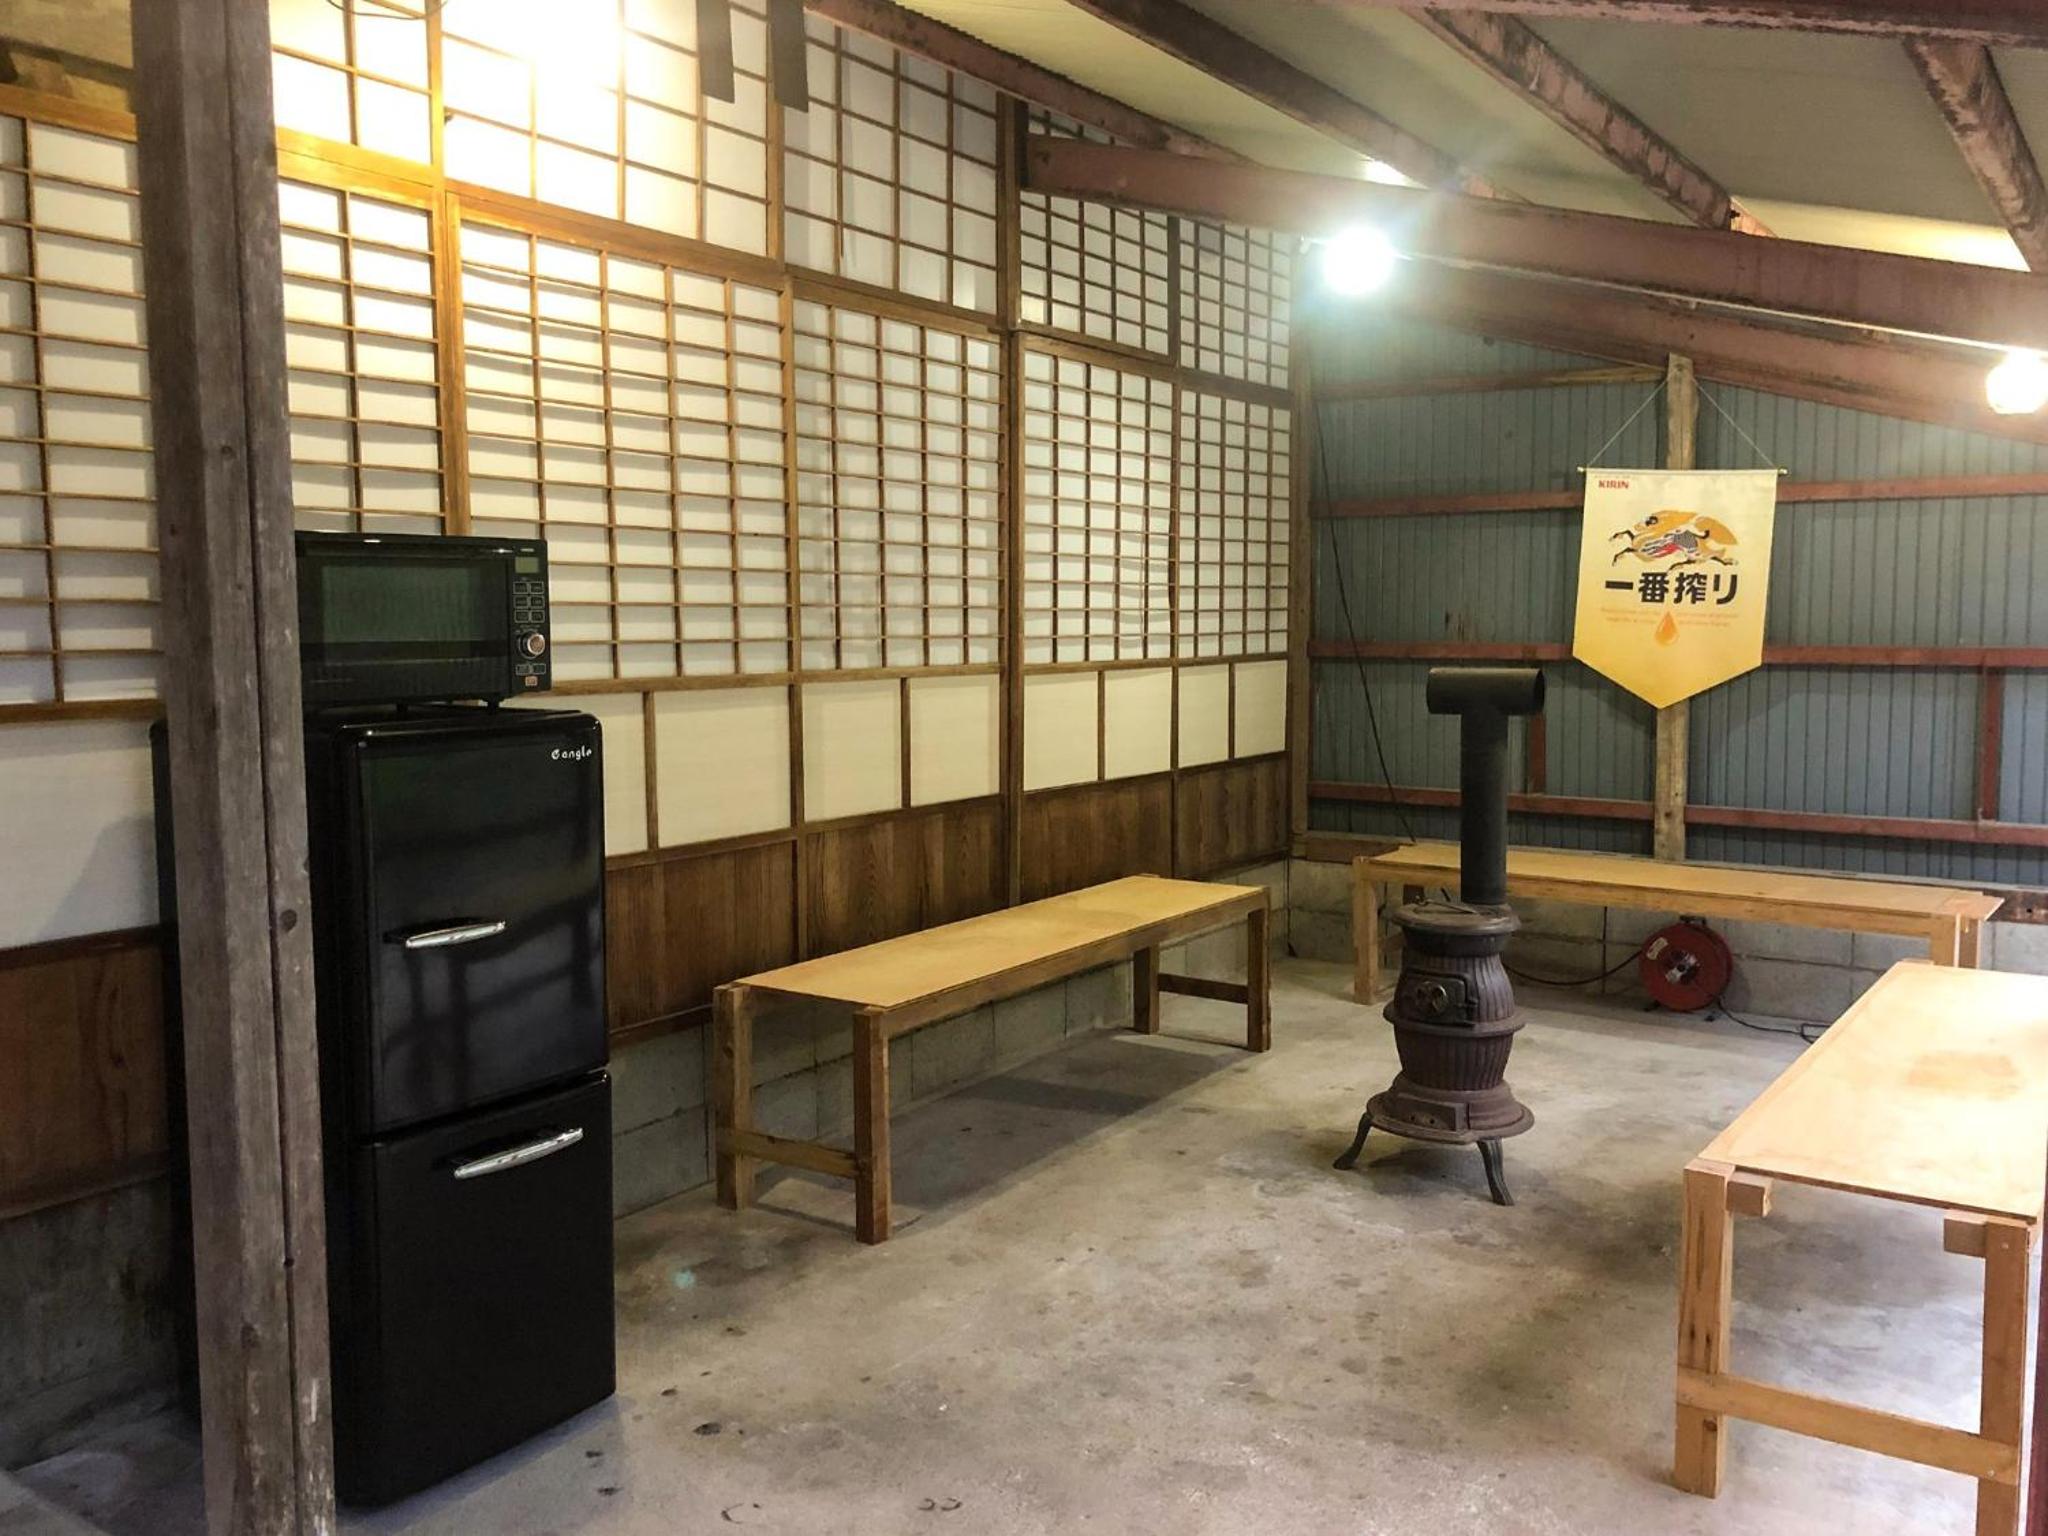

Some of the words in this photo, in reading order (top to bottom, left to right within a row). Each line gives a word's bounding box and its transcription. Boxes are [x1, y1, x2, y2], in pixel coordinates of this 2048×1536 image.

[1598, 480, 1630, 489] KIRIN
[1605, 572, 1738, 605] 一番搾り
